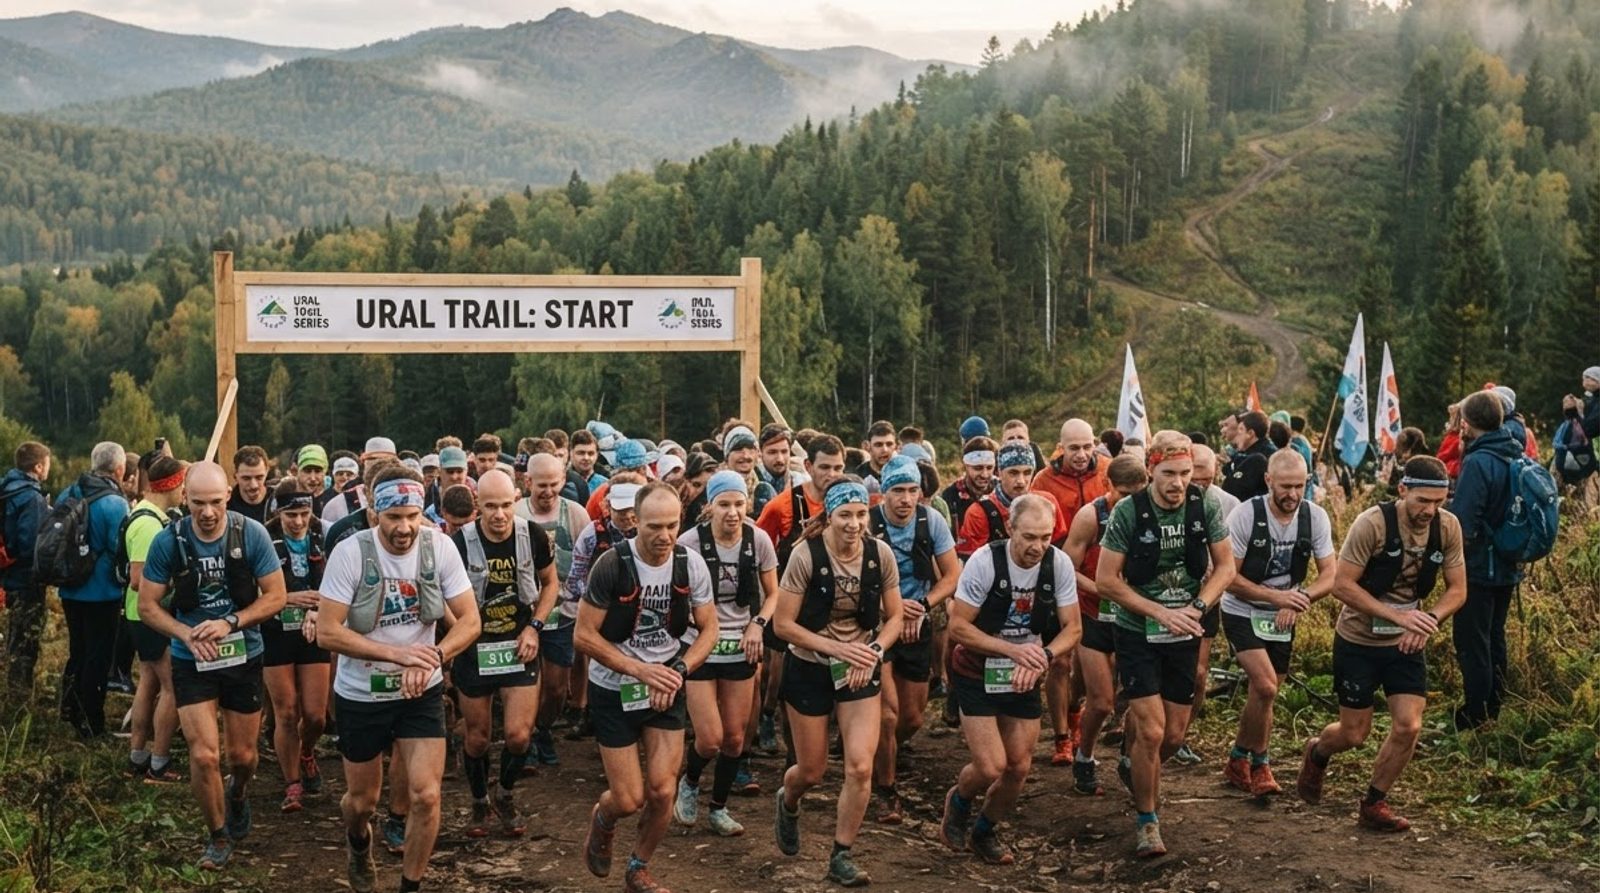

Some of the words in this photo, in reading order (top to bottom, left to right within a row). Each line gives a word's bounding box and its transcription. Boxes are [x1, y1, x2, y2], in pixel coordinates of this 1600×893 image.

[294, 296, 320, 305] URAL
[356, 299, 435, 329] URAL
[444, 299, 536, 329] TRAIL:
[545, 299, 634, 329] START
[293, 318, 329, 328] SERIES
